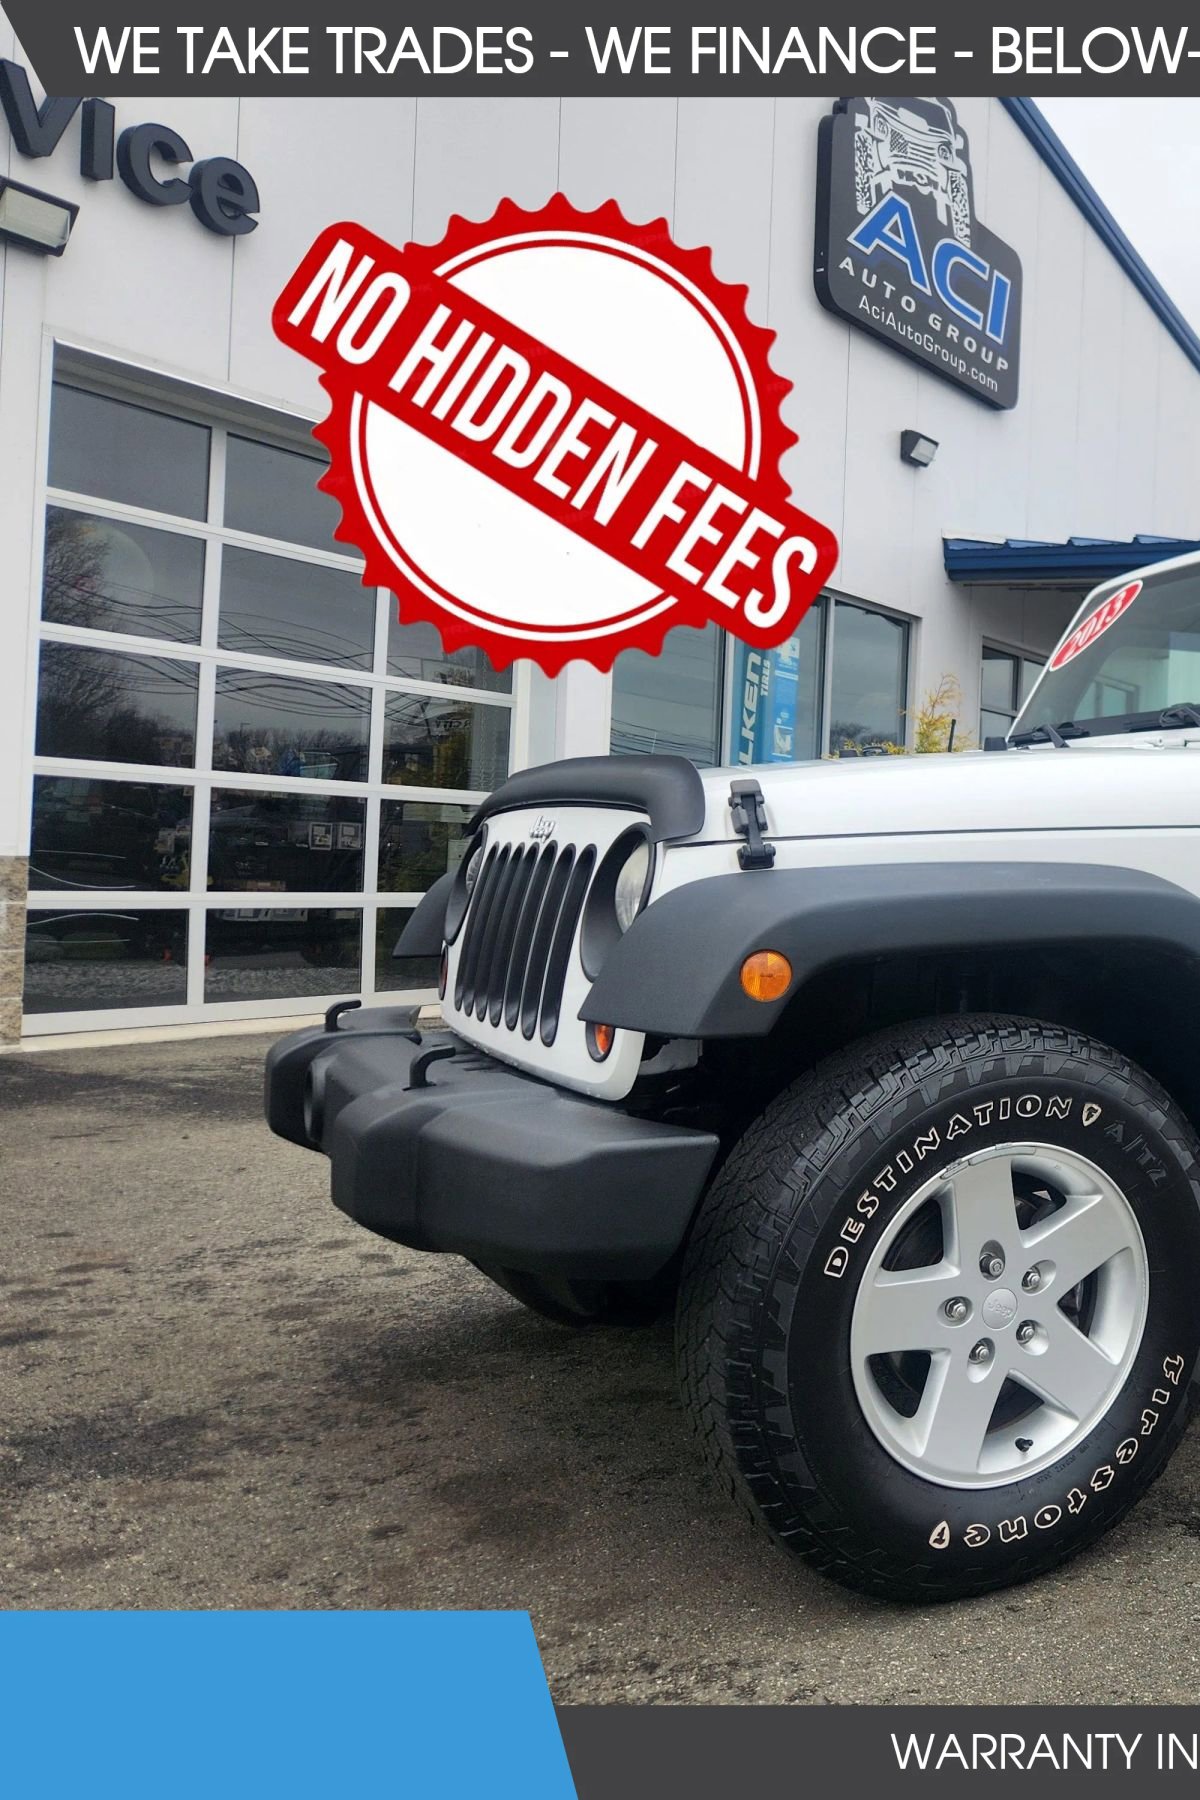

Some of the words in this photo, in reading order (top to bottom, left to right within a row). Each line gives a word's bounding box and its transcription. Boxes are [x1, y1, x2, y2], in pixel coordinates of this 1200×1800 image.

[839, 256, 916, 313] AUTO
[928, 313, 1009, 371] GROUP
[847, 190, 1011, 345] ACI
[858, 295, 998, 392] AciAutoGroup.com
[760, 659, 771, 697] TIRES
[1062, 590, 1127, 661] 2013
[737, 652, 762, 765] LKEN
[823, 1093, 1074, 1279] DESTINATION
[963, 1354, 1185, 1548] Firestone
